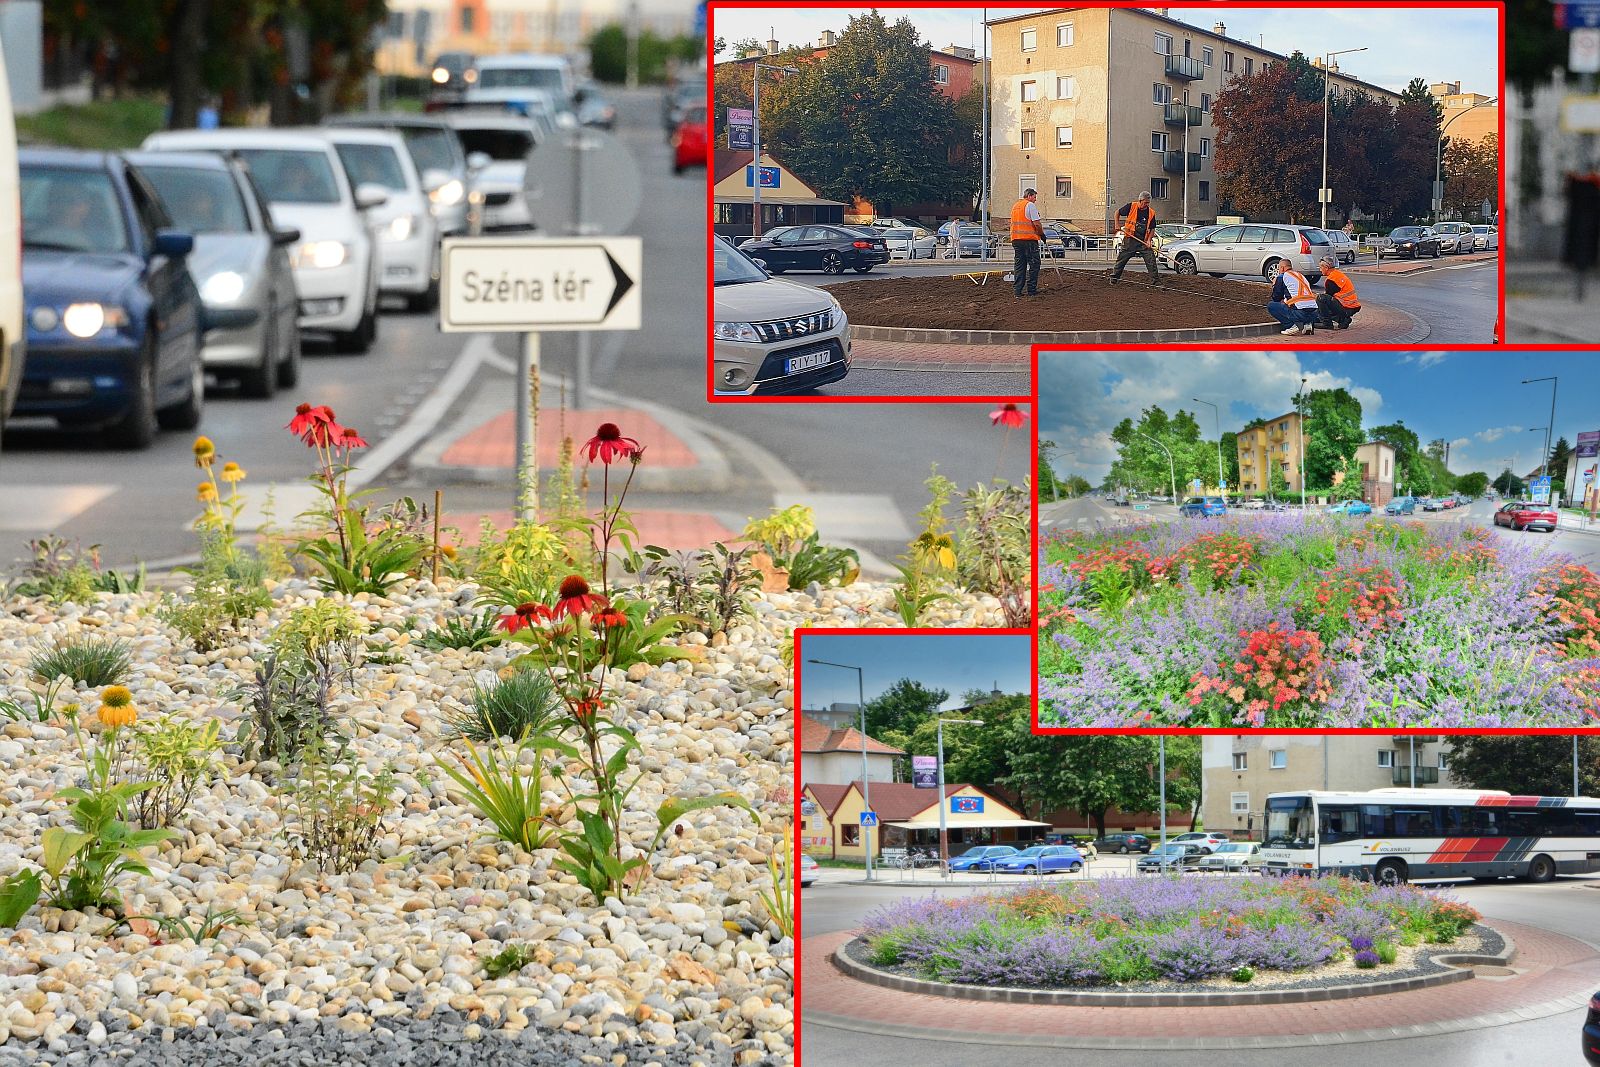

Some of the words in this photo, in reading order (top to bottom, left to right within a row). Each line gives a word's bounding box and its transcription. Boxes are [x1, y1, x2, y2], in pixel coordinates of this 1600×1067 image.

[463, 269, 544, 303] Széna
[553, 269, 592, 302] tér
[791, 351, 829, 370] RIY-117
